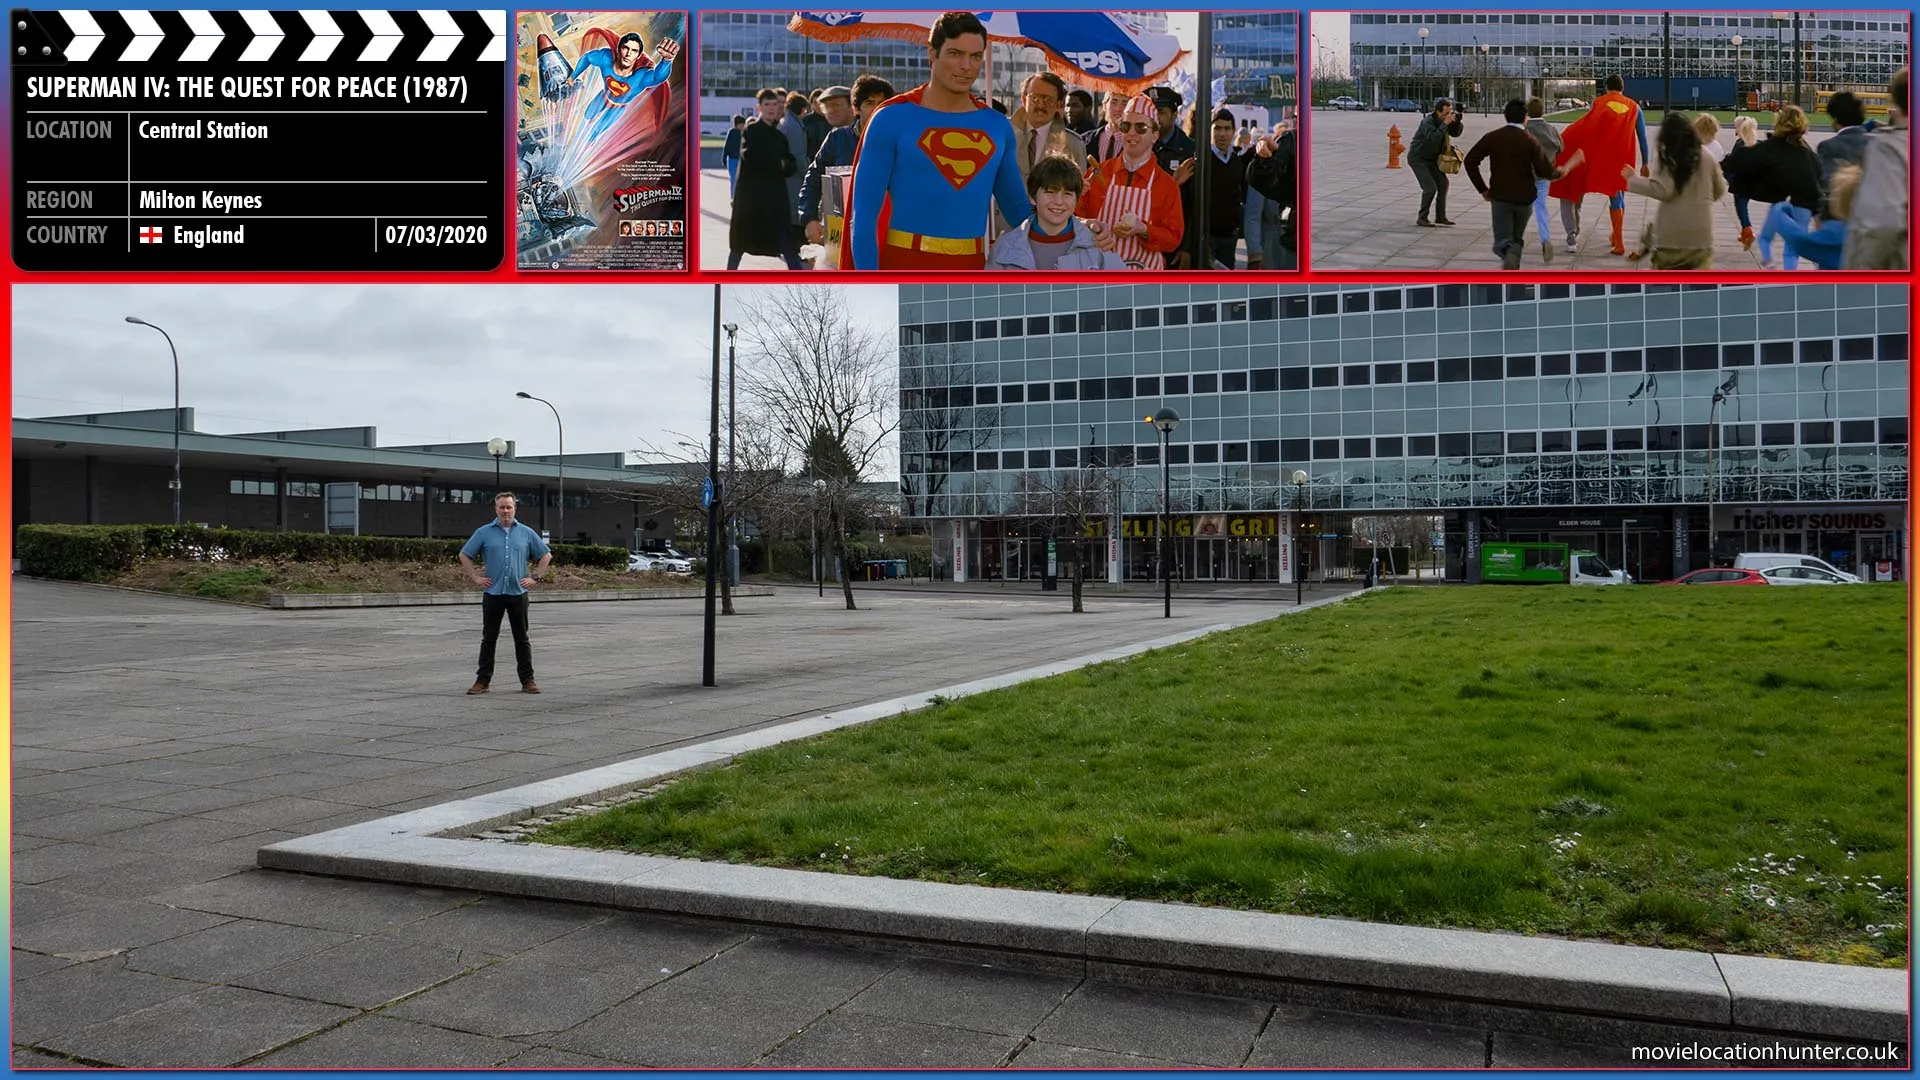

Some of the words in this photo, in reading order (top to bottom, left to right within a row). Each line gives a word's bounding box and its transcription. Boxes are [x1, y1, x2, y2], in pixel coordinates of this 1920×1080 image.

[618, 189, 671, 213] SUPERMAN
[671, 186, 682, 195] IV
[641, 197, 658, 207] QUEST
[1084, 519, 1192, 538] SIZLING
